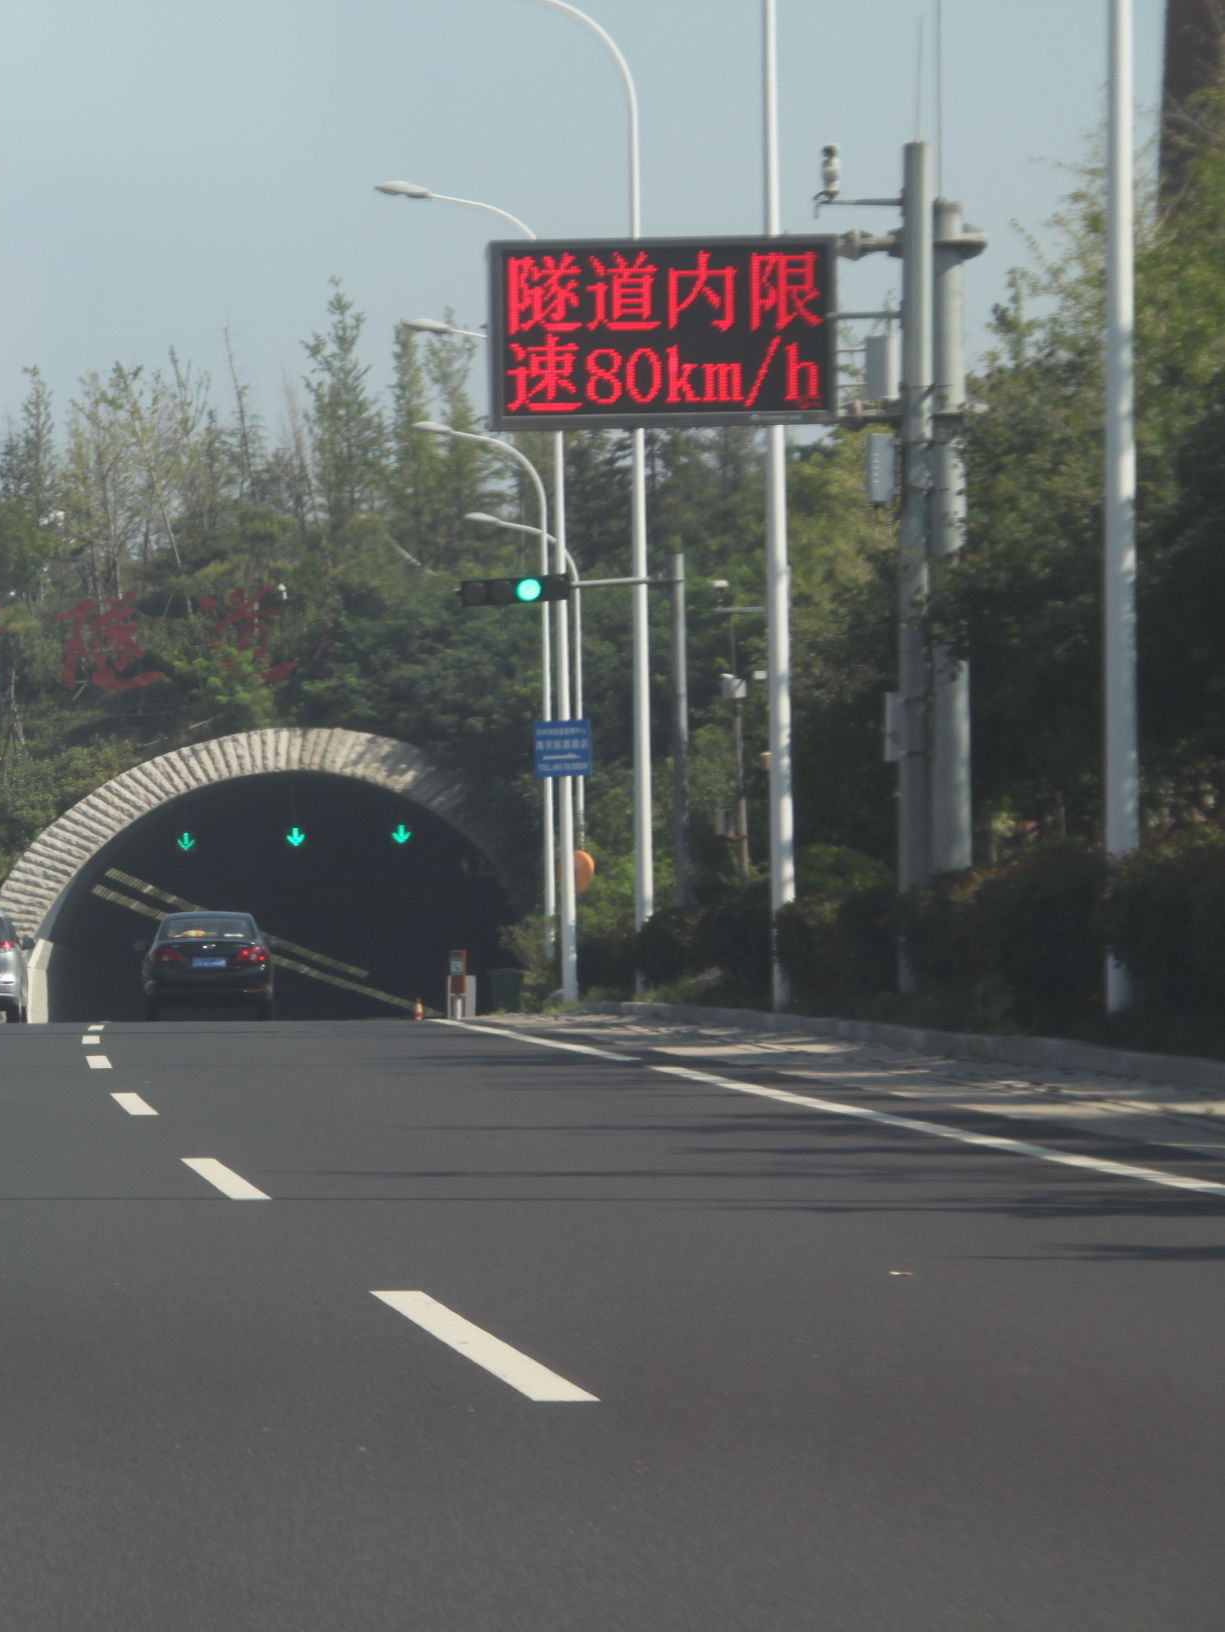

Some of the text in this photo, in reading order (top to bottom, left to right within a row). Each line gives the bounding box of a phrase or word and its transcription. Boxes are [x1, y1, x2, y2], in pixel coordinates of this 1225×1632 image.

[507, 250, 825, 335] 隧道内限
[506, 333, 823, 412] 速80km/h
